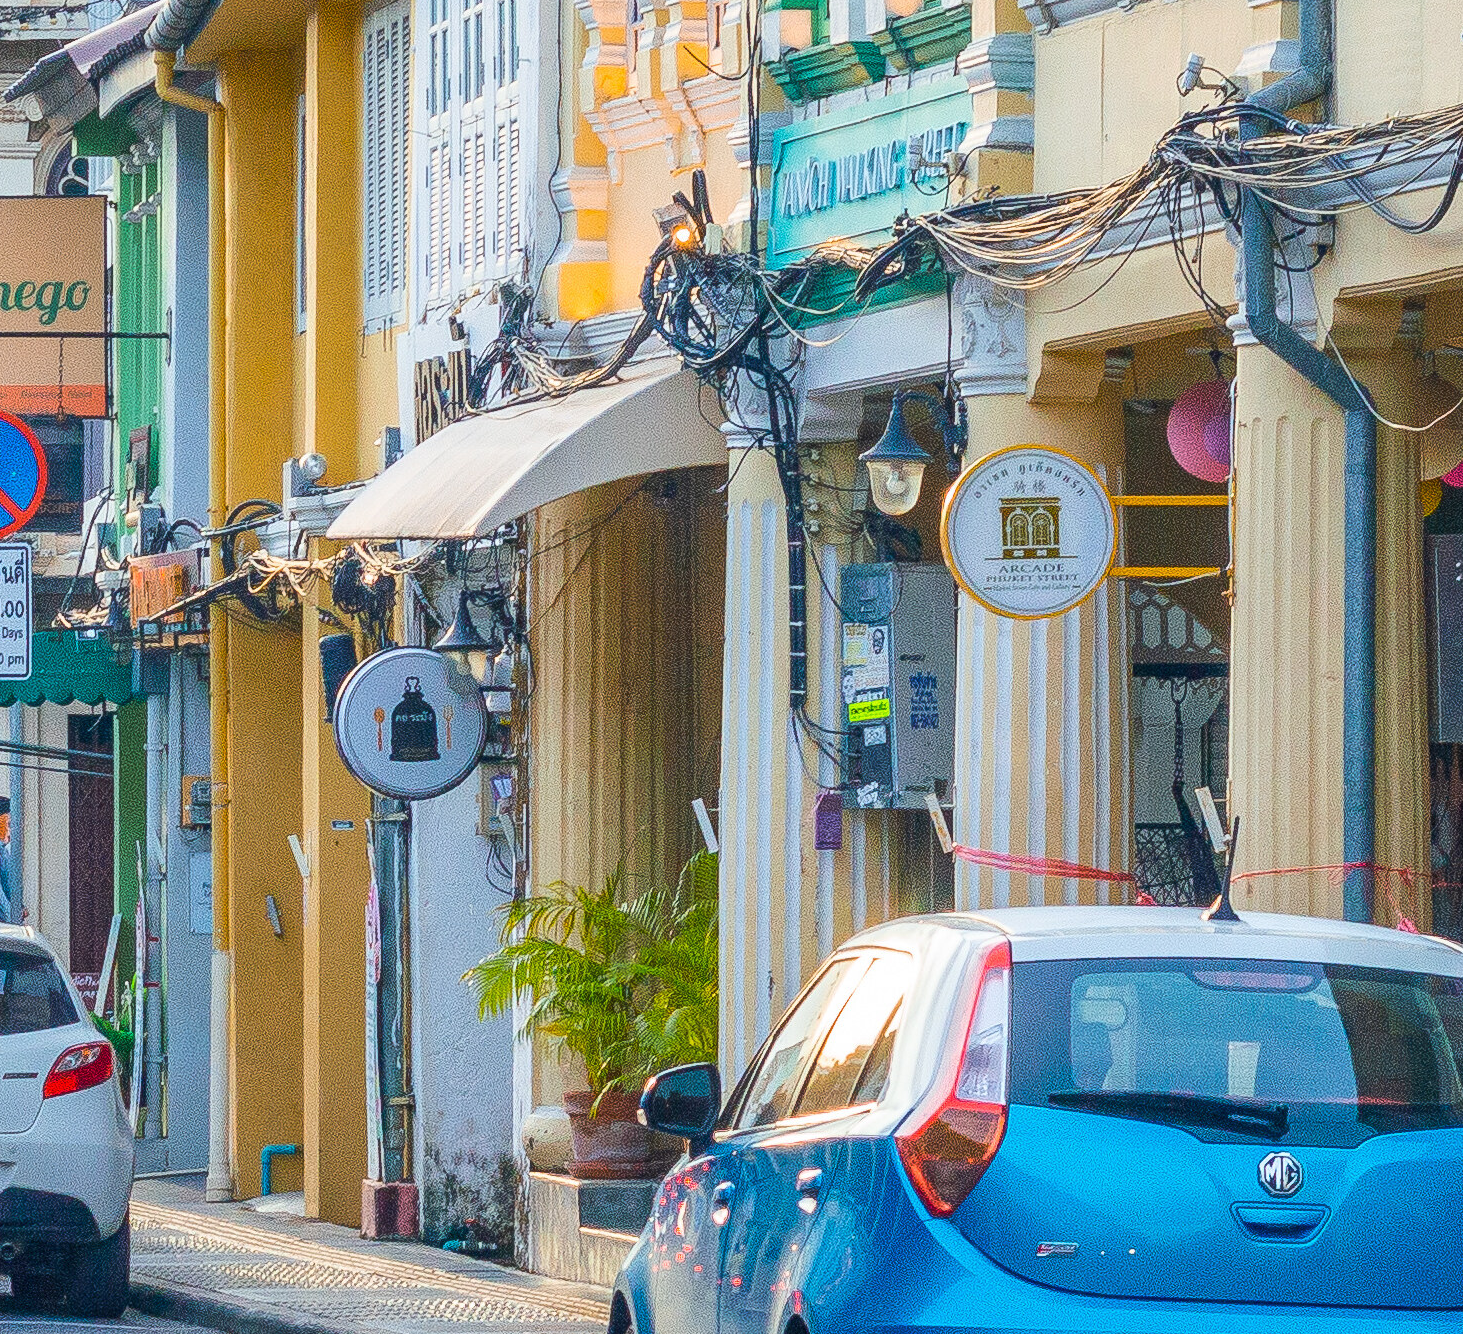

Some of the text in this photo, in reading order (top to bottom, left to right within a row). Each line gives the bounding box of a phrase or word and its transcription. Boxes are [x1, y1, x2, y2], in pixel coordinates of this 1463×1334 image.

[999, 563, 1065, 574] ARCADE
[2, 627, 24, 642] Days
[7, 653, 25, 666] pm
